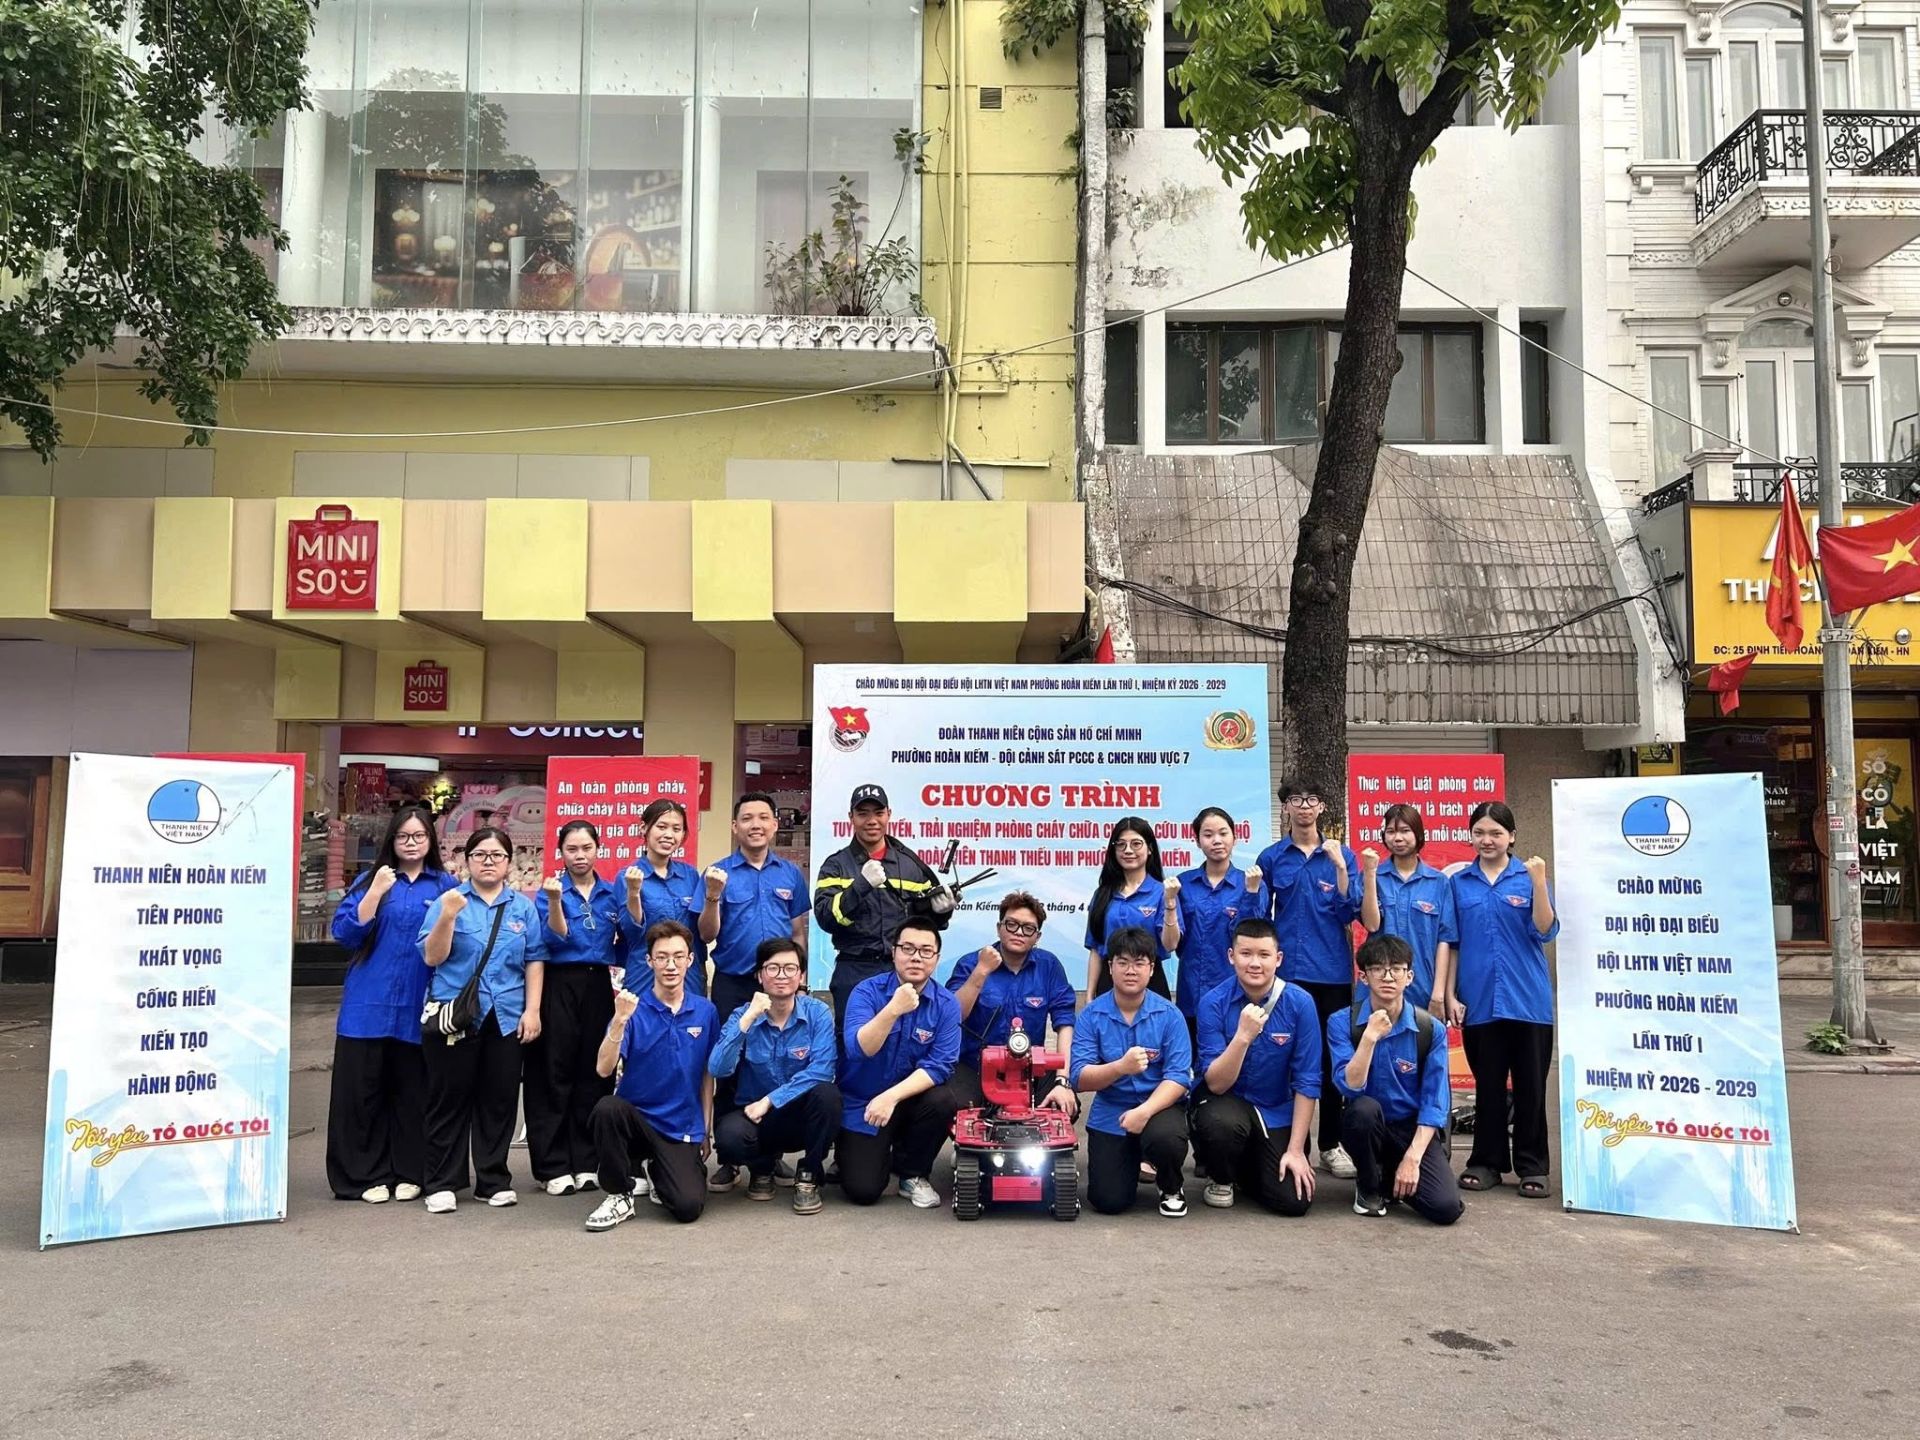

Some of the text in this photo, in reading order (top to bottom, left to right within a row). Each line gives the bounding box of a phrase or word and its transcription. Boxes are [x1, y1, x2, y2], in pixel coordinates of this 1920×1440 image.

[297, 534, 368, 561] MINI
[296, 568, 337, 595] SO
[1713, 645, 1731, 655] ĐC:
[1733, 645, 1745, 655] 25
[1794, 643, 1823, 655] HOÀN
[1896, 646, 1910, 656] HN
[408, 674, 443, 688] MINI
[856, 676, 875, 690] CHÀO
[876, 676, 899, 690] MỪNG
[901, 678, 913, 692] ĐẠI
[914, 676, 927, 692] HỘI
[929, 678, 941, 692] ĐẠI
[960, 676, 972, 692] HỘI
[974, 679, 992, 690] LHTN
[994, 676, 1009, 692] VIỆT
[1010, 679, 1028, 690] NAM
[1030, 676, 1059, 690] PHƯỜNG
[1061, 676, 1081, 690] HOÀN
[1082, 676, 1101, 691] KIẾM
[1141, 677, 1166, 693] NHIỆM
[1167, 677, 1177, 690] KỲ
[1178, 679, 1199, 690] 2026
[1206, 679, 1227, 690] 2029
[408, 690, 428, 703] SO
[938, 725, 965, 741] ĐOÀN
[968, 727, 1000, 741] THANH
[1002, 725, 1025, 741] NIÊN
[1027, 725, 1054, 743] CỘNG
[1056, 724, 1076, 741] SẢN
[1096, 726, 1113, 741] CHÍ
[1115, 728, 1142, 741] MINH
[891, 747, 1190, 767] PHƯỜNG HOÀN KIẾM ĐỘI CẢNH SÁT PCCC & CNCH KHU VỰC 7
[557, 781, 573, 794] An
[581, 780, 606, 794] toàn
[614, 780, 649, 795] phòng
[857, 786, 880, 798] 114
[921, 780, 1161, 807] CHƯƠNG TRÌNH
[1357, 775, 1496, 793] Thực hiện Luật phòng cháy
[1861, 783, 1888, 802] CÔ
[557, 803, 627, 816] chữa cháy là
[1358, 801, 1370, 816] và
[1426, 801, 1435, 816] là
[1439, 801, 1463, 816] trách
[161, 822, 209, 831] THANH NIÊN
[165, 829, 183, 838] VIỆT
[606, 824, 624, 838] gia
[833, 822, 855, 838] TUY
[919, 817, 943, 838] TRẢI
[945, 819, 991, 841] NGHIỆM
[995, 818, 1033, 838] PHÒNG
[1036, 819, 1065, 838] CHÁY
[1069, 819, 1099, 838] CHỮA
[1155, 821, 1178, 839] CỨU
[1181, 823, 1197, 842] NẠ
[1359, 826, 1370, 842] và
[1640, 843, 1657, 851] VIỆT
[1662, 836, 1680, 844] NIÊN
[1860, 838, 1898, 861] VIỆT
[980, 848, 1191, 867] THANH THIẾU NHI PHƯỜ KIẾM
[93, 863, 267, 884] THANH NIÊN HOÀN KIẾM
[1861, 870, 1901, 885] NAM
[1617, 876, 1702, 895] CHÀO MỪNG
[137, 904, 223, 925] TIÊN PHONG
[1047, 902, 1076, 913] tháng
[1078, 903, 1085, 911] 4
[1605, 916, 1627, 935] ĐẠI
[1632, 913, 1655, 936] HỘI
[1659, 916, 1683, 936] ĐẠI
[138, 946, 222, 969] KHÁT VỌNG
[1597, 950, 1732, 975] HỘI LHTN VIỆT NAM
[136, 986, 216, 1009] CỐNG HIẾN
[1595, 989, 1738, 1015] PHƯỜNG HOÀN KIẾM
[140, 1029, 208, 1052] KIẾN TẠO
[1664, 1033, 1703, 1053] THỨ I
[127, 1070, 217, 1096] HÀNH ĐỘNG
[1586, 1067, 1757, 1098] NHIỆM KỲ 2026 2029
[183, 1118, 234, 1139] QUỐC
[240, 1117, 269, 1133] TÔI
[1684, 1121, 1734, 1139] QUỐC
[1739, 1127, 1770, 1142] TÔI
